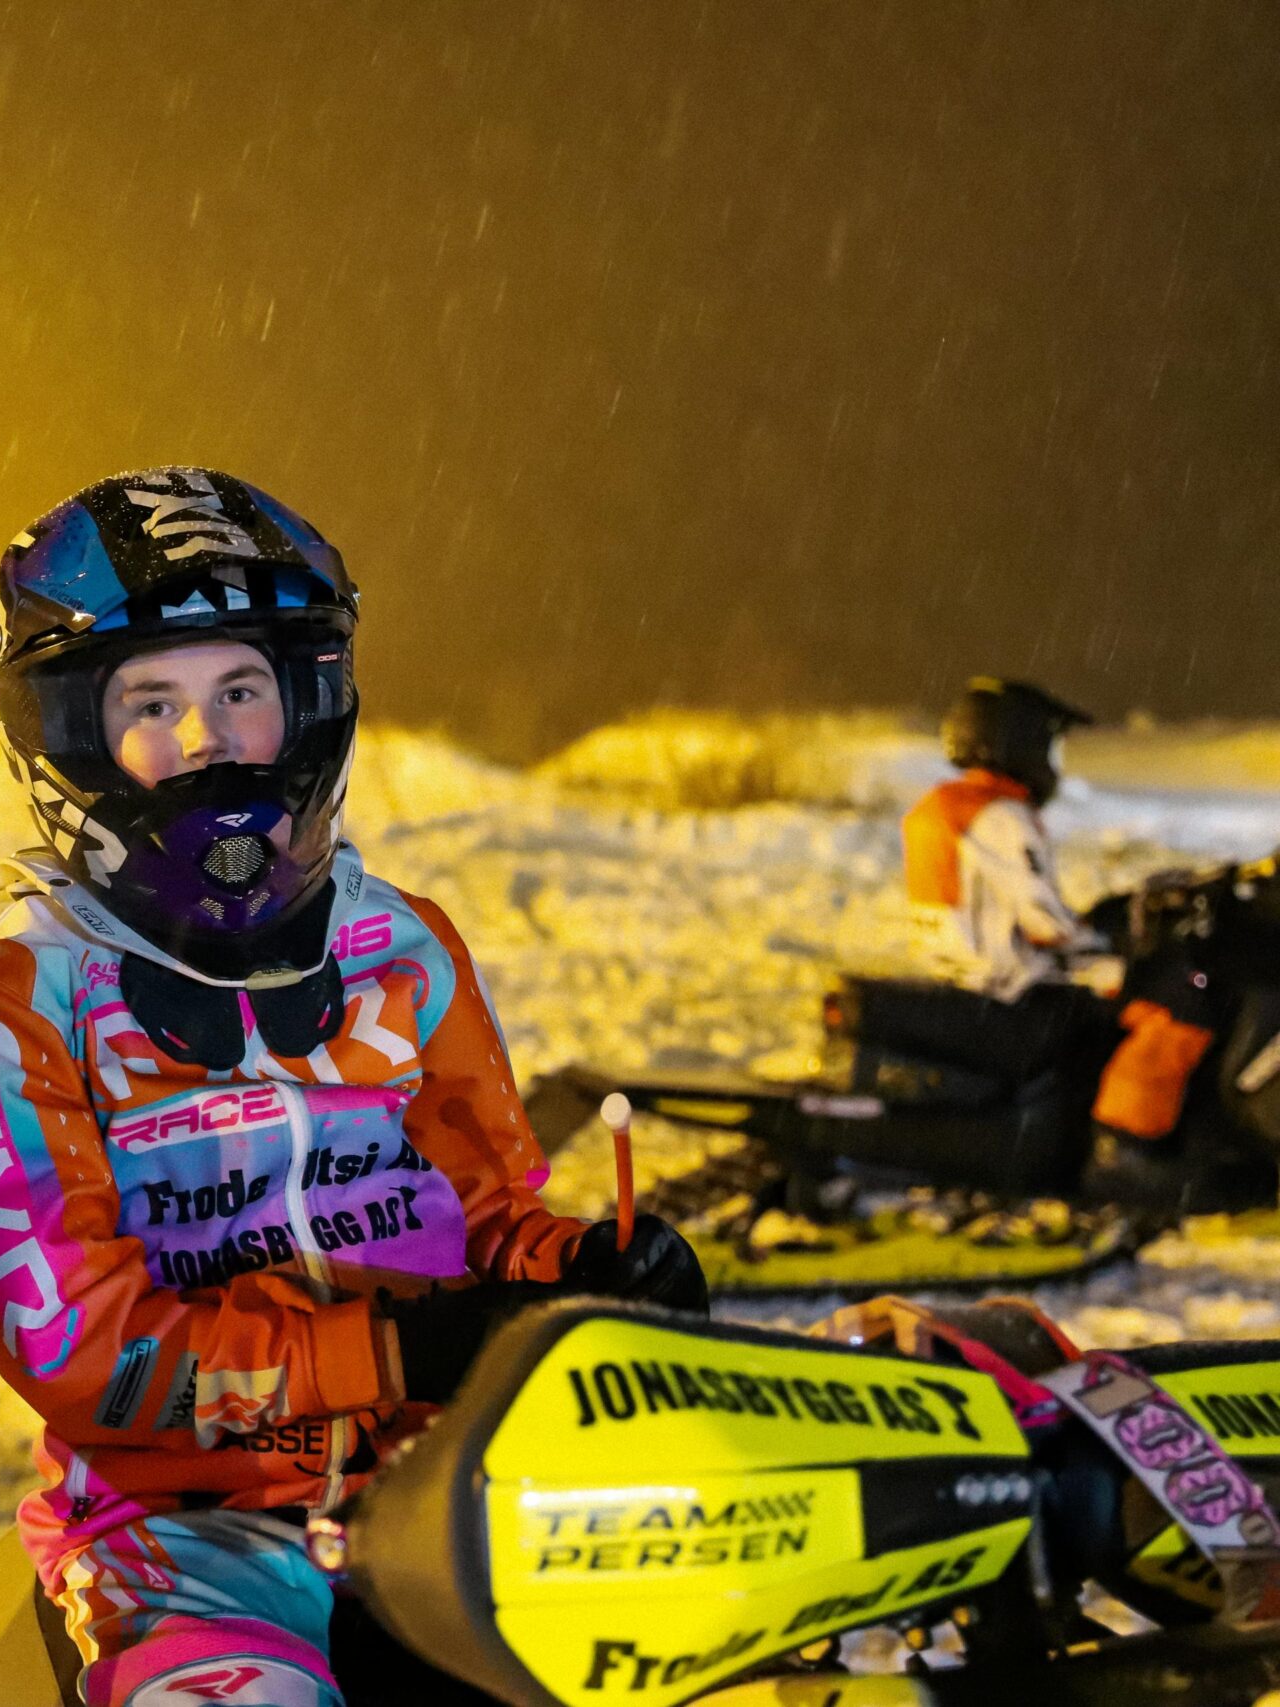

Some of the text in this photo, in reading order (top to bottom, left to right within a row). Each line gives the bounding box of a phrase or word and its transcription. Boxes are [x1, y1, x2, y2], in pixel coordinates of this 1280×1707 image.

[109, 1085, 290, 1151] RACE
[568, 1359, 942, 1436] JONASBYGG AS
[535, 1502, 738, 1537] TEAM
[537, 1527, 809, 1572] PERSEN
